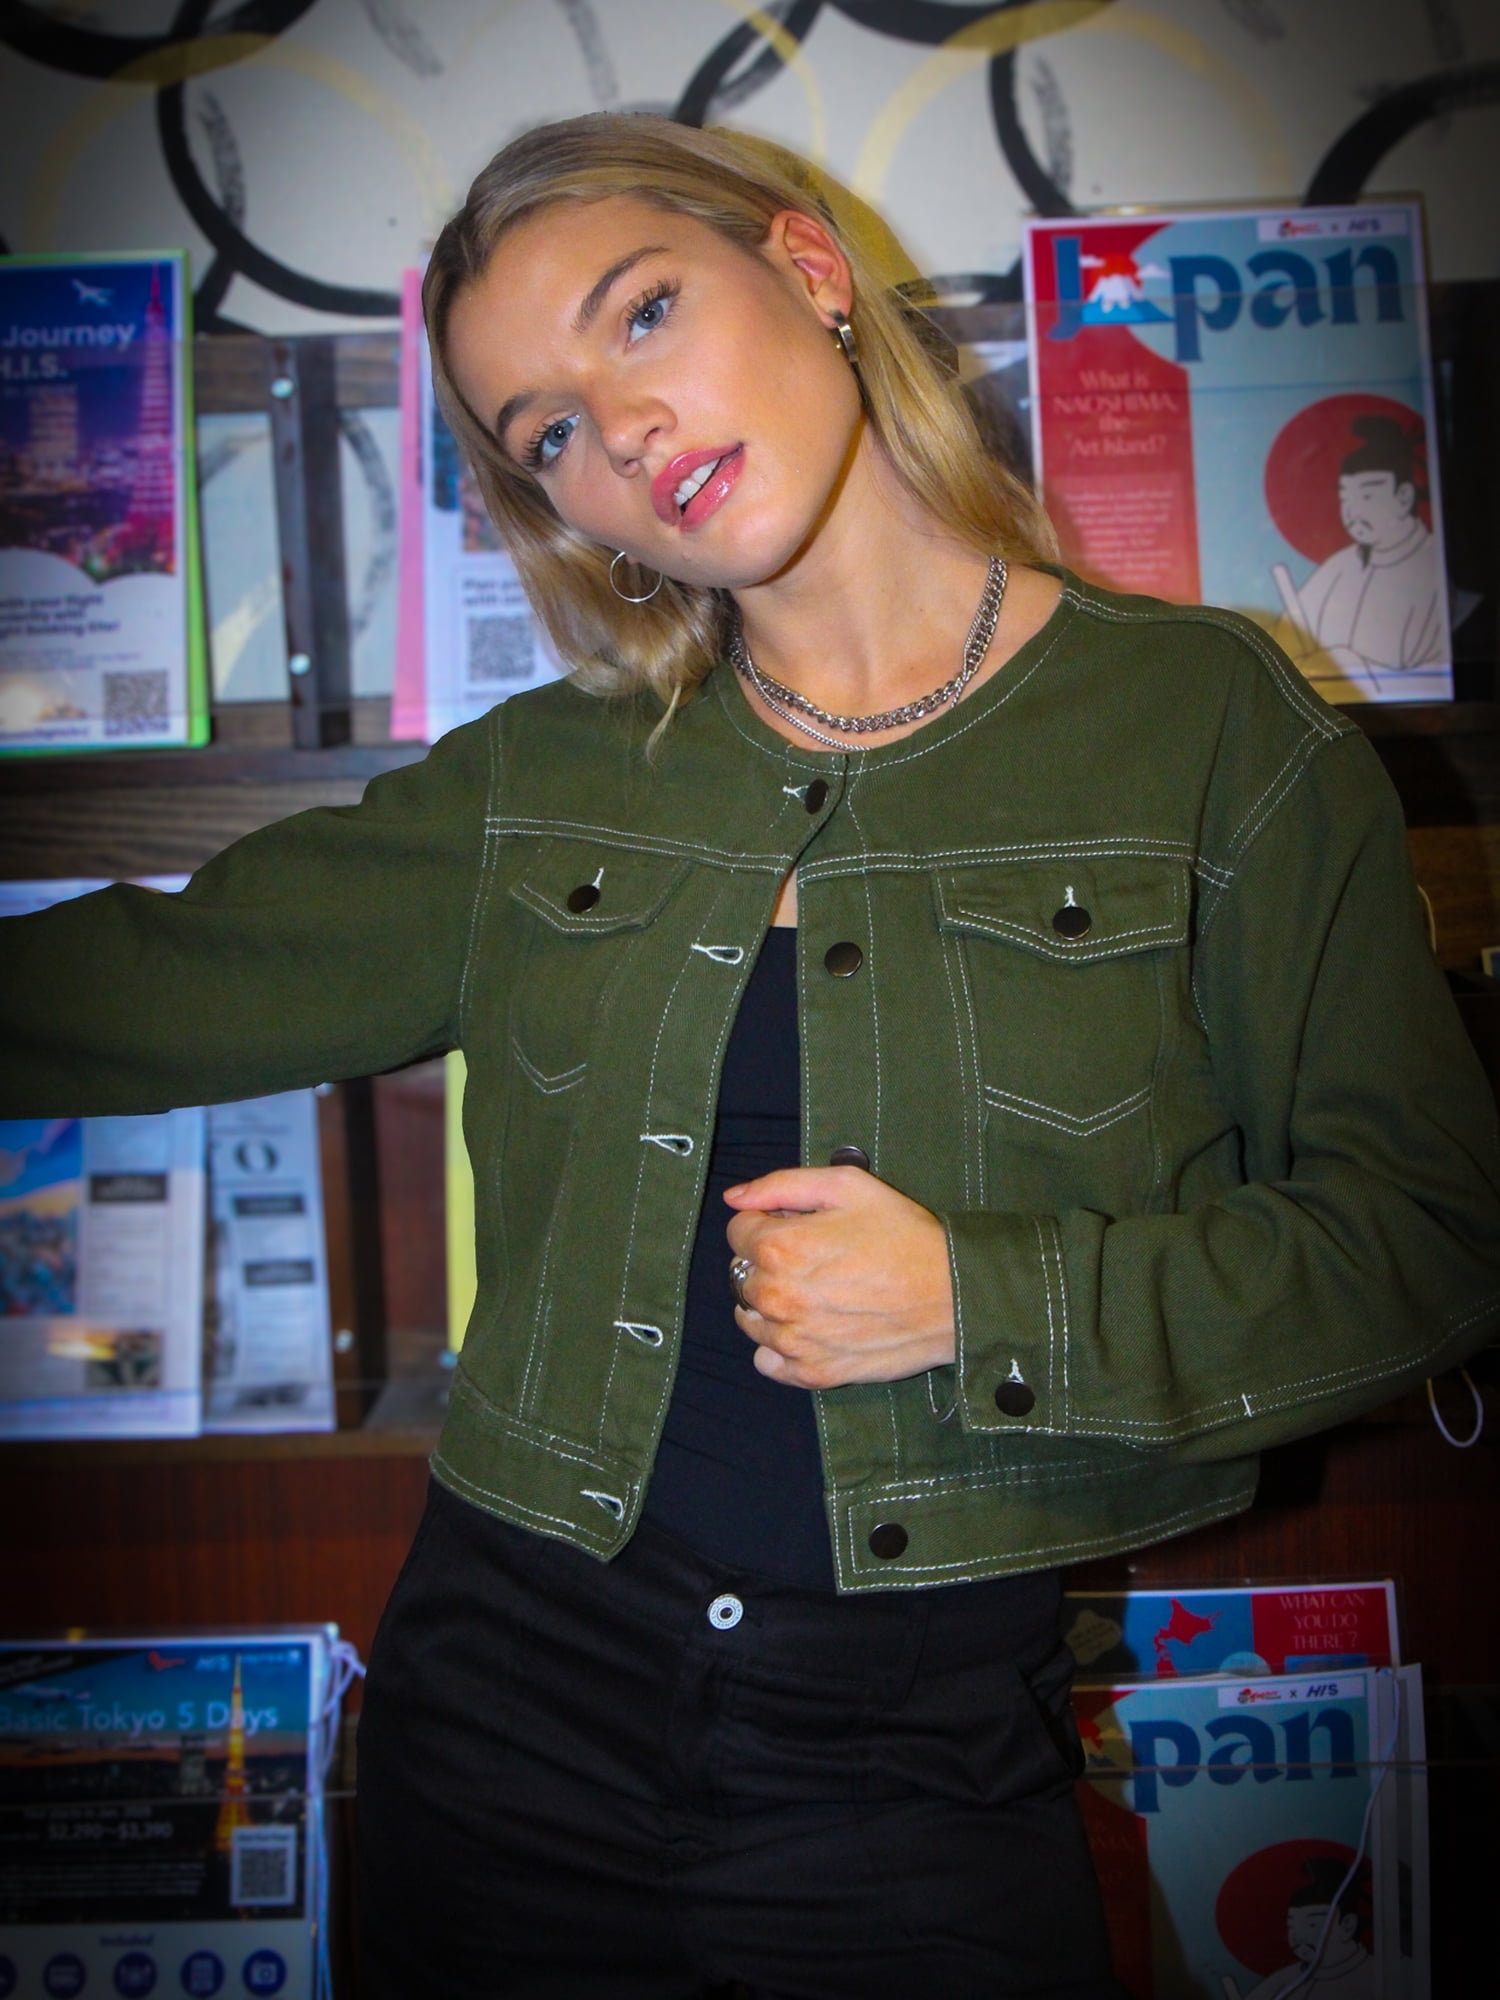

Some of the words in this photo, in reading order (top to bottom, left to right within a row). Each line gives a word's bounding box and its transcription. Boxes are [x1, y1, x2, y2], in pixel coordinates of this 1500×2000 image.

[2, 323, 136, 352] Journey
[1079, 370, 1130, 390] What
[1279, 1593, 1327, 1611] WHAT
[1330, 1592, 1366, 1608] CAN
[1293, 1613, 1329, 1630] YOU
[1332, 1611, 1359, 1628] DO
[1293, 1633, 1345, 1650] THERE
[1306, 1682, 1339, 1698] HIS
[0, 1705, 68, 1733] Basic
[78, 1702, 166, 1738] Tokyo
[177, 1702, 195, 1729] 5
[206, 1702, 279, 1737] Days
[1128, 1708, 1358, 1814] pan
